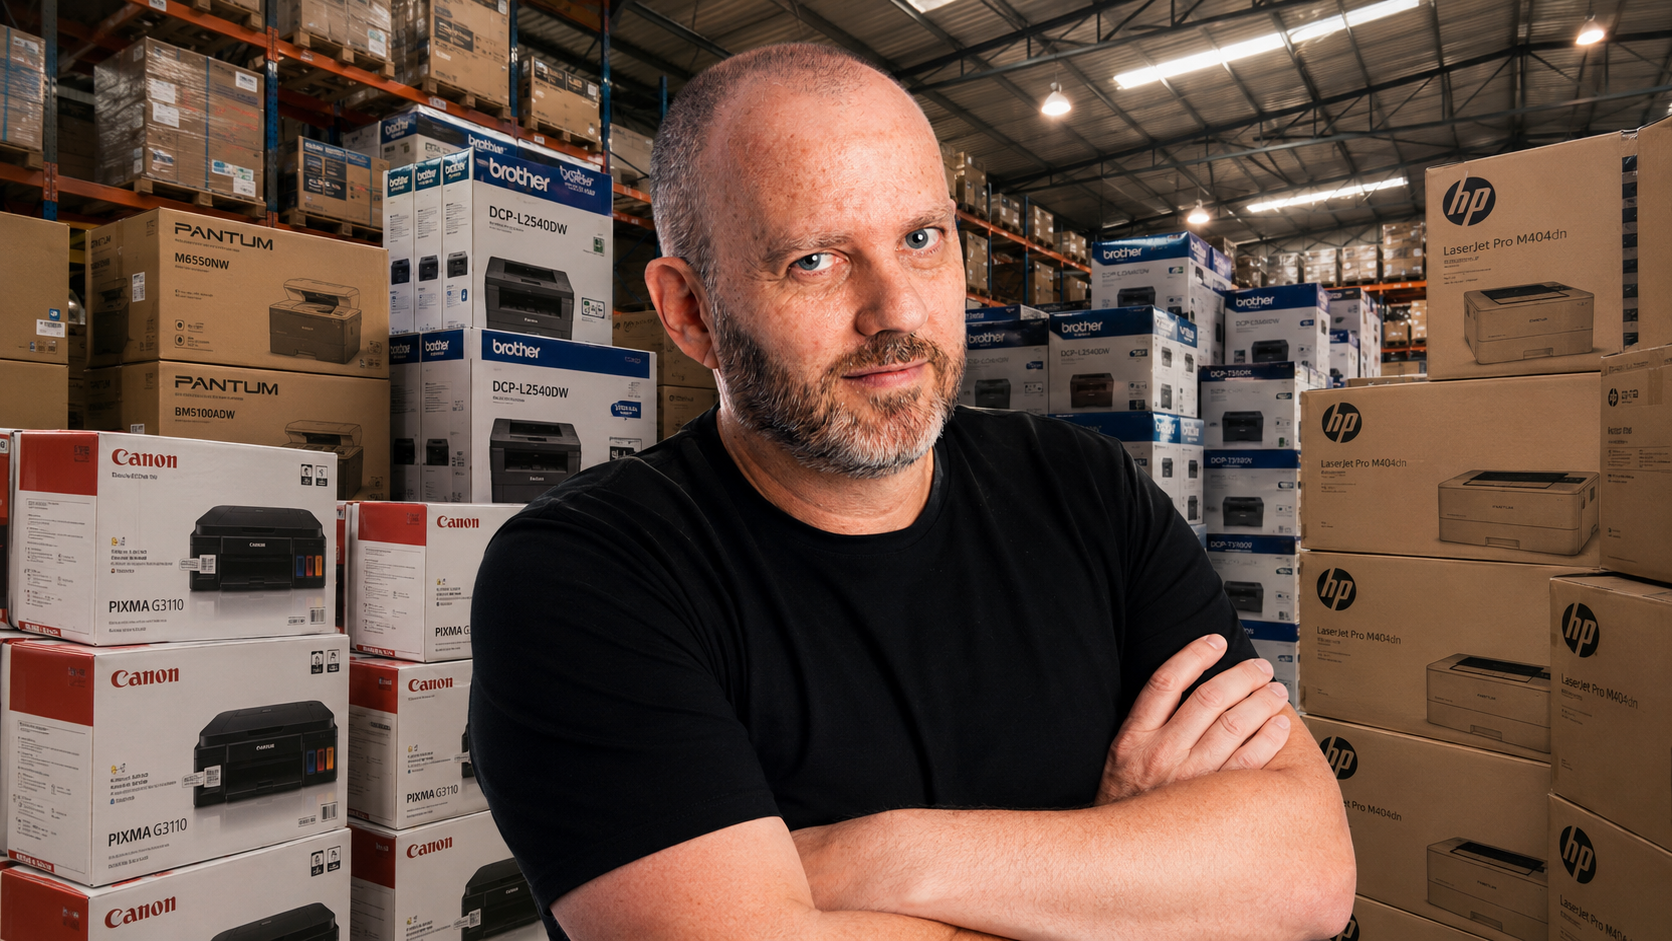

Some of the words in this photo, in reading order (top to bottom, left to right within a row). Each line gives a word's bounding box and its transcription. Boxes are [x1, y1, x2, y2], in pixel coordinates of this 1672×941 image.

[489, 157, 550, 192] brother
[1444, 174, 1496, 226] hp
[489, 205, 568, 235] DCP-L2540DW
[175, 222, 273, 251] PANTUM
[1443, 239, 1490, 256] LaserJet
[1493, 237, 1514, 249] Pro
[1516, 229, 1568, 245] M404dn
[175, 252, 230, 270] M6550NW
[1103, 247, 1143, 260] brother
[1236, 295, 1275, 307] brother
[968, 332, 1006, 344] brother
[1061, 321, 1103, 334] brother
[492, 339, 541, 359] brother
[175, 375, 279, 396] PANTUM
[492, 380, 569, 399] DCP-L2540DW
[175, 406, 236, 420] BM5100ADW
[1322, 402, 1362, 443] hp
[111, 448, 178, 469] Canon
[1320, 459, 1354, 469] LaserJet
[1356, 458, 1370, 468] Pro
[1371, 458, 1407, 468] M404dn
[437, 515, 480, 528] Canon
[1316, 568, 1356, 611] hp
[109, 600, 150, 613] PIXMA
[151, 598, 184, 612] G3110
[435, 626, 462, 637] PIXMA
[1317, 626, 1349, 640] LaserJet
[1350, 630, 1365, 640] Pro
[1366, 632, 1402, 645] M404dn
[1562, 602, 1600, 658] hp
[111, 667, 180, 688] Canon
[408, 677, 454, 693] Canon
[1561, 673, 1591, 694] LaserJet
[1592, 683, 1605, 698] Pro
[406, 789, 435, 803] PIXMA
[436, 784, 459, 798] G3110
[1352, 801, 1366, 812] Pro
[1367, 805, 1402, 822] M404dn
[108, 825, 152, 847] PIXMA
[153, 817, 188, 837] G3110
[406, 837, 453, 858] Canon
[1560, 826, 1596, 884] hp
[104, 896, 177, 929] Canon
